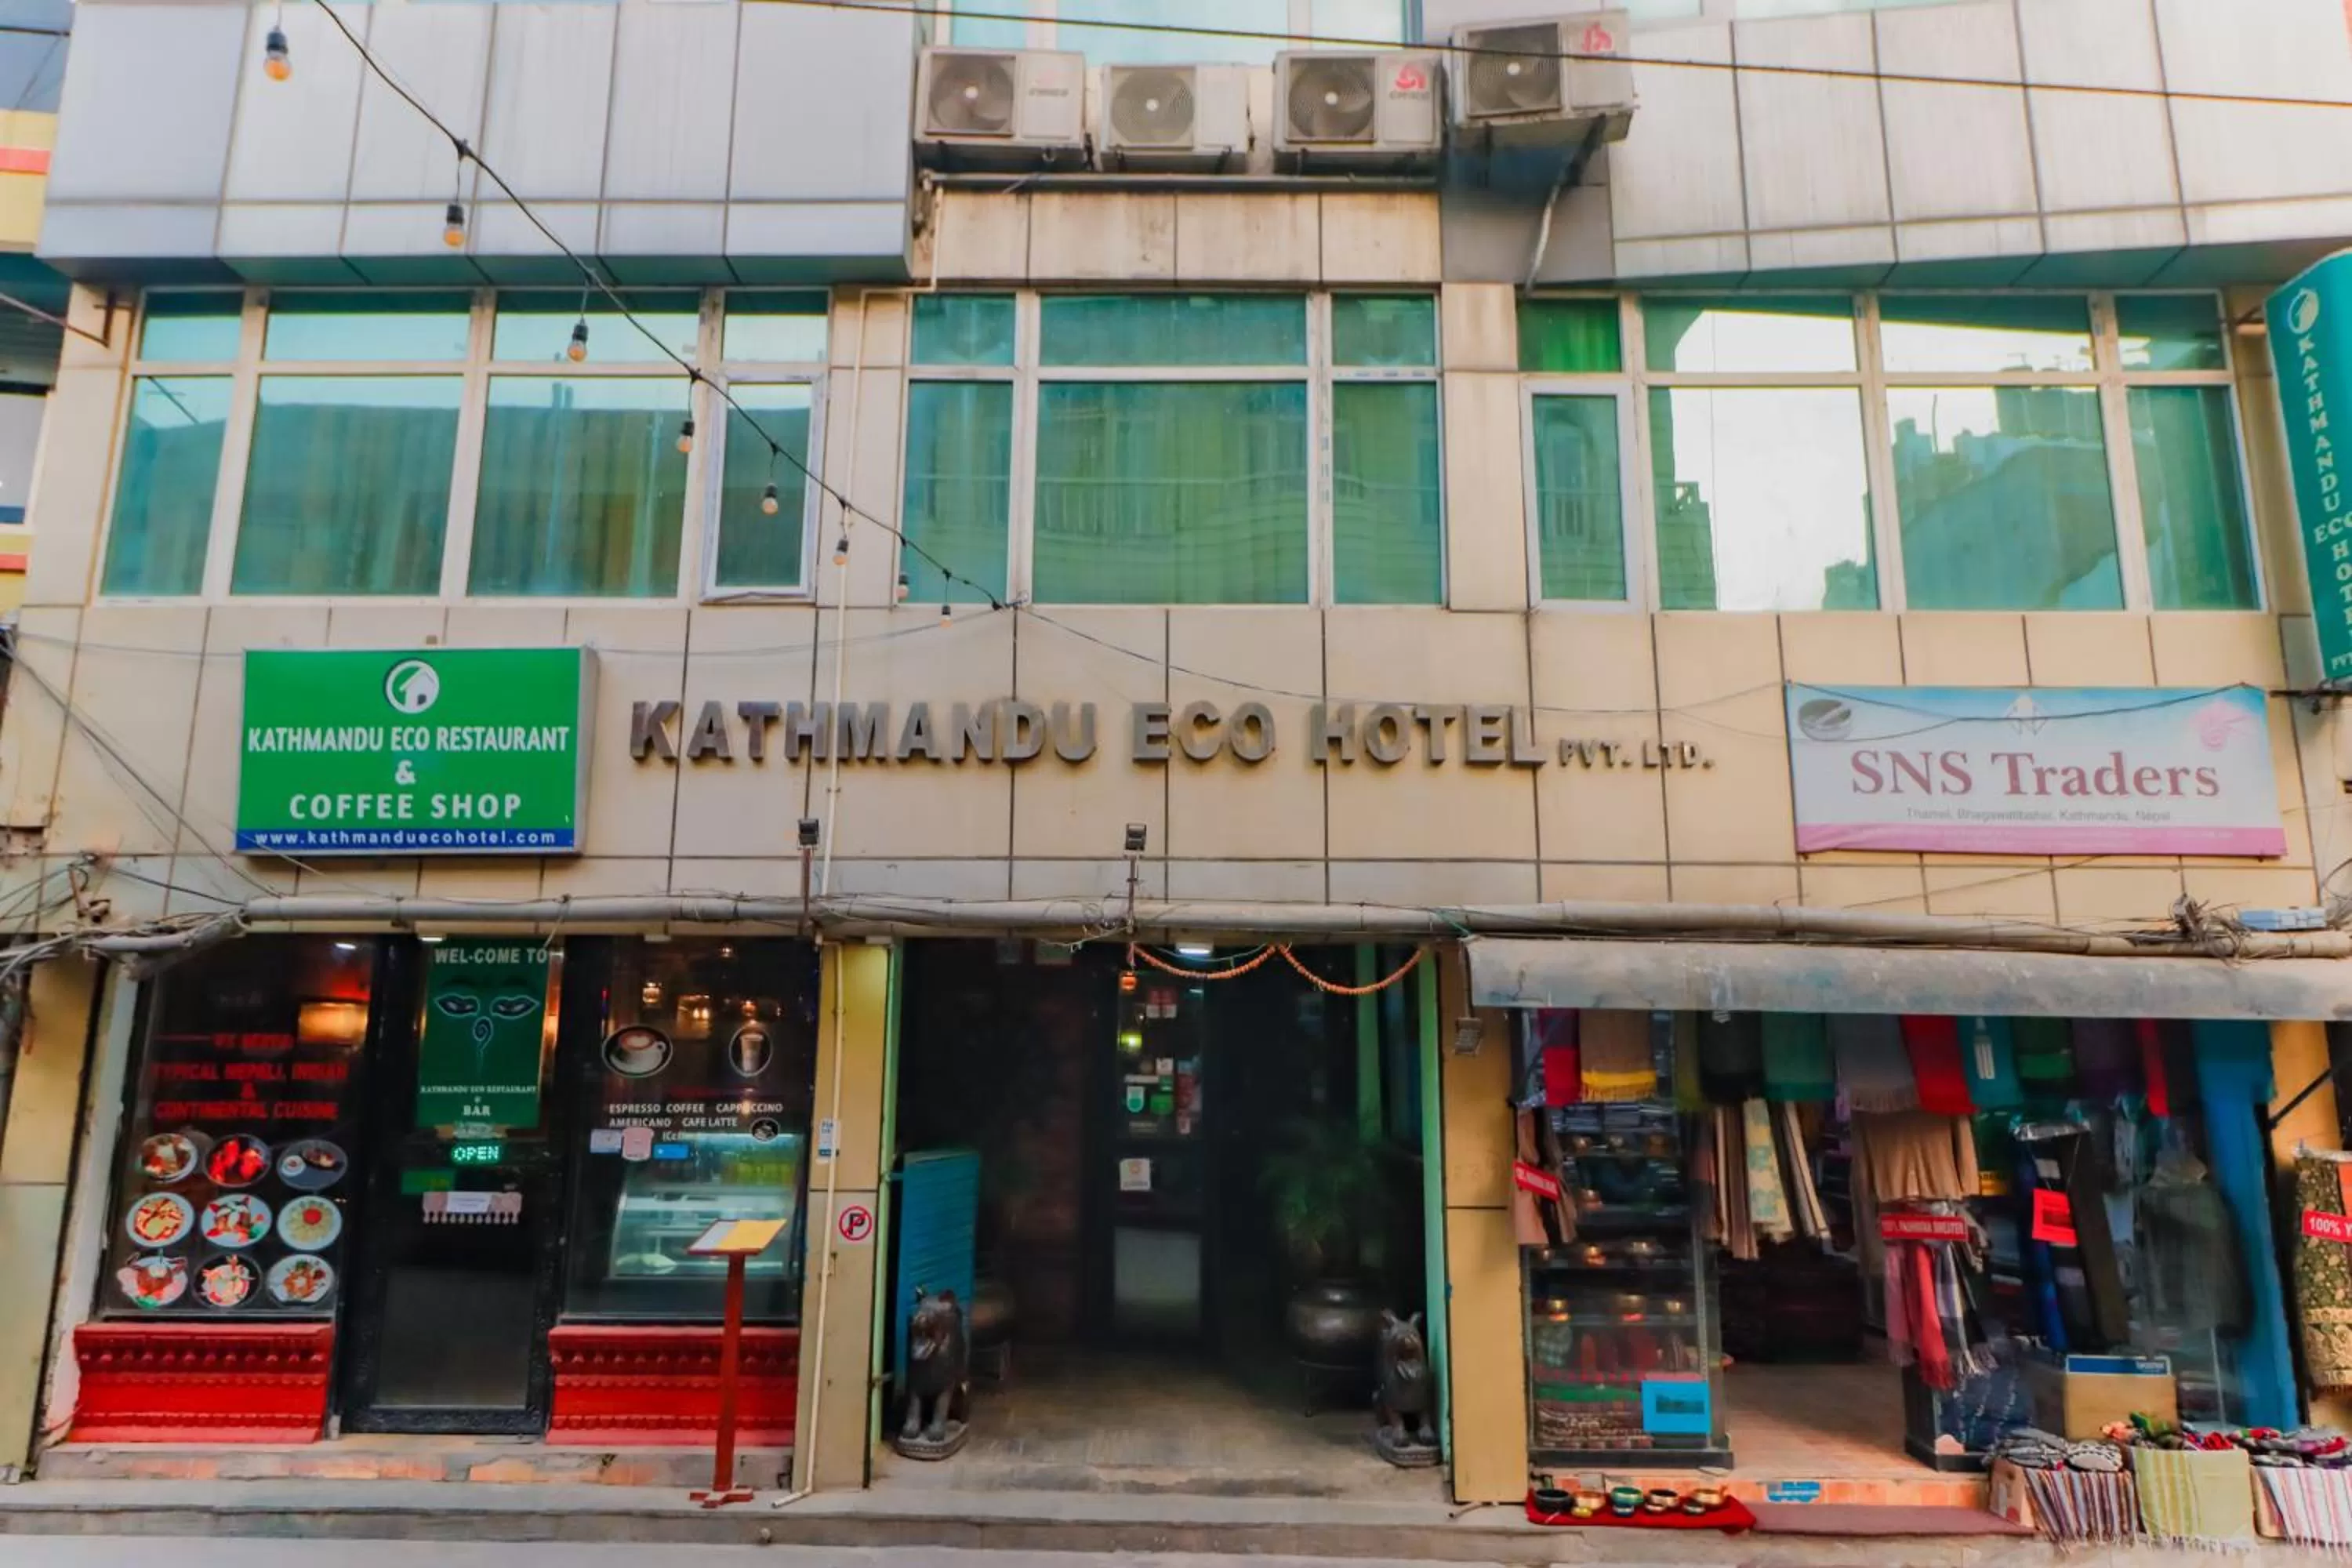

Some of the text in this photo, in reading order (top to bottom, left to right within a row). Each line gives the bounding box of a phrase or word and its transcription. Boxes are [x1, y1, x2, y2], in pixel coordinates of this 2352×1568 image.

[248, 726, 569, 753] KATHMANDU ECO RESTAURANT
[630, 700, 1716, 770] KATHMANDU ECO HOTEL PVT. LTD.
[394, 760, 416, 786] &
[1850, 750, 2220, 798] SNS Traders
[289, 794, 521, 820] COFFEE SHOP
[255, 830, 556, 846] www.kathmanduecohotel.com
[434, 947, 548, 964] WEL-COME TO
[463, 1105, 491, 1116] BAR
[609, 1103, 783, 1114] ESPRESSO COFFEE CAPPCCINO
[609, 1117, 738, 1127] AMERICANO CAFE LATTE
[453, 1145, 500, 1162] OPEN
[2308, 1216, 2340, 1236] 100%
